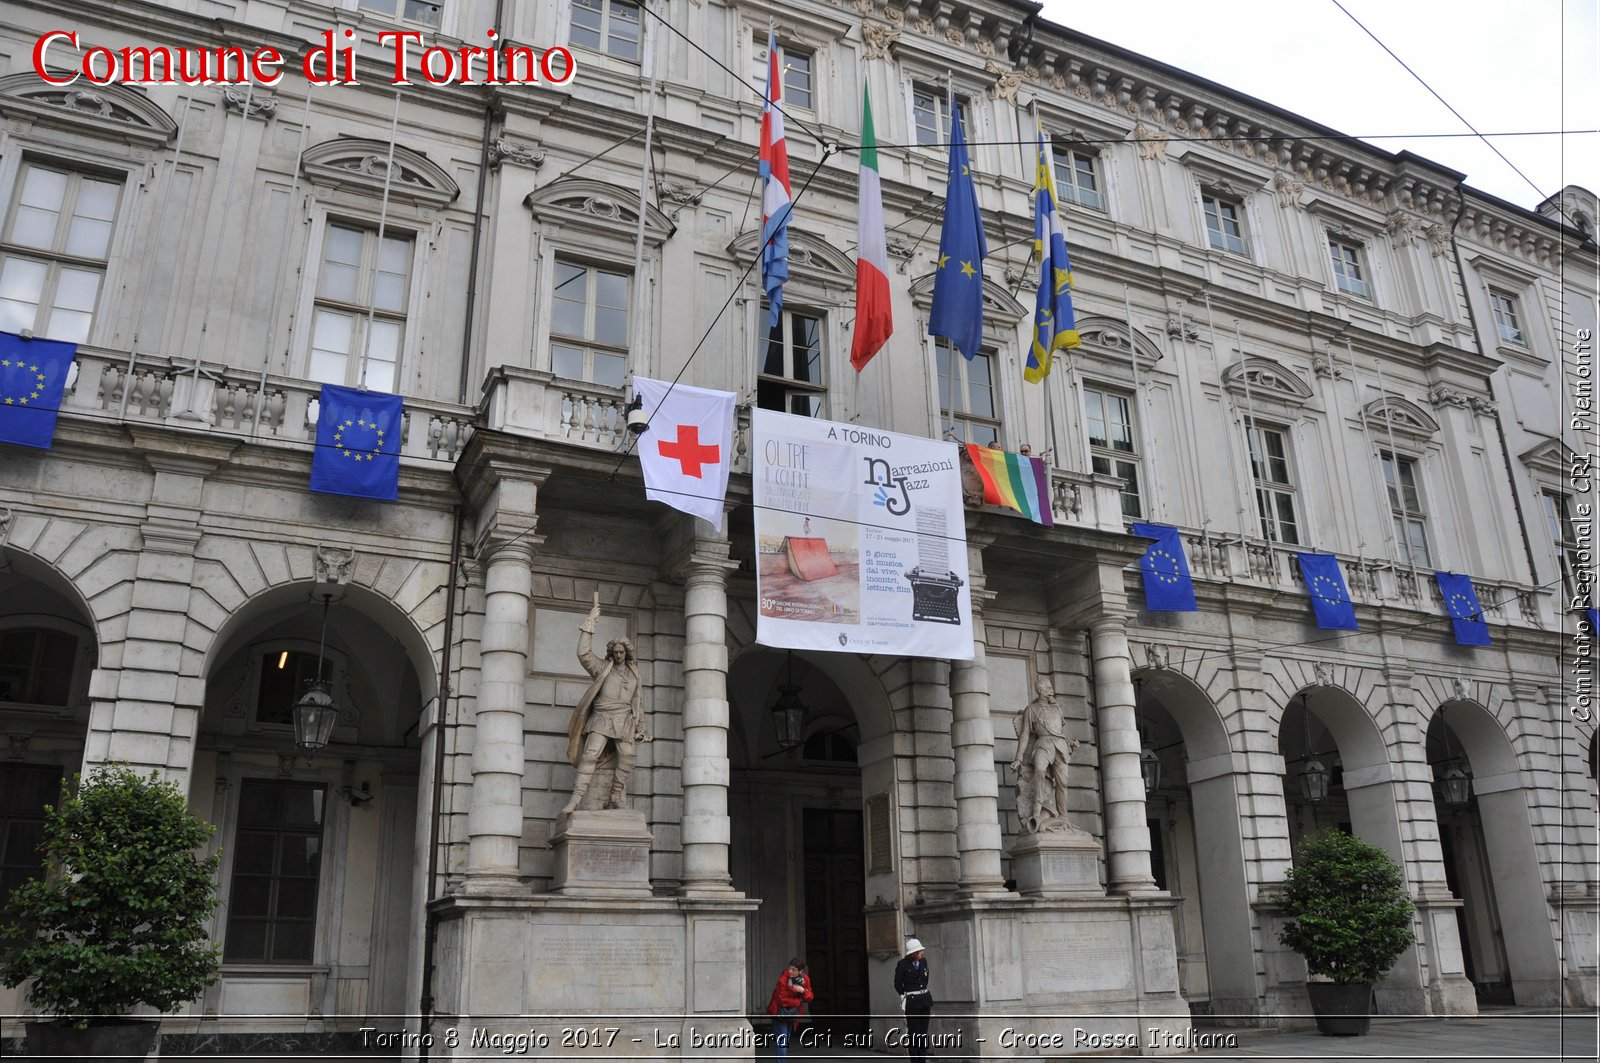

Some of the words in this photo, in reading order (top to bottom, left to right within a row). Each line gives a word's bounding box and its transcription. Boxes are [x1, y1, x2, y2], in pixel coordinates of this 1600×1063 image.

[827, 426, 838, 440] A
[841, 428, 892, 449] TORINO
[765, 438, 810, 472] OLTRE
[886, 477, 930, 517] Jazz
[874, 551, 897, 559] giorni
[876, 560, 904, 568] musica
[881, 568, 900, 576] vivo,
[866, 576, 900, 585] incontri,
[866, 584, 895, 593] letture,
[896, 585, 911, 594] film
